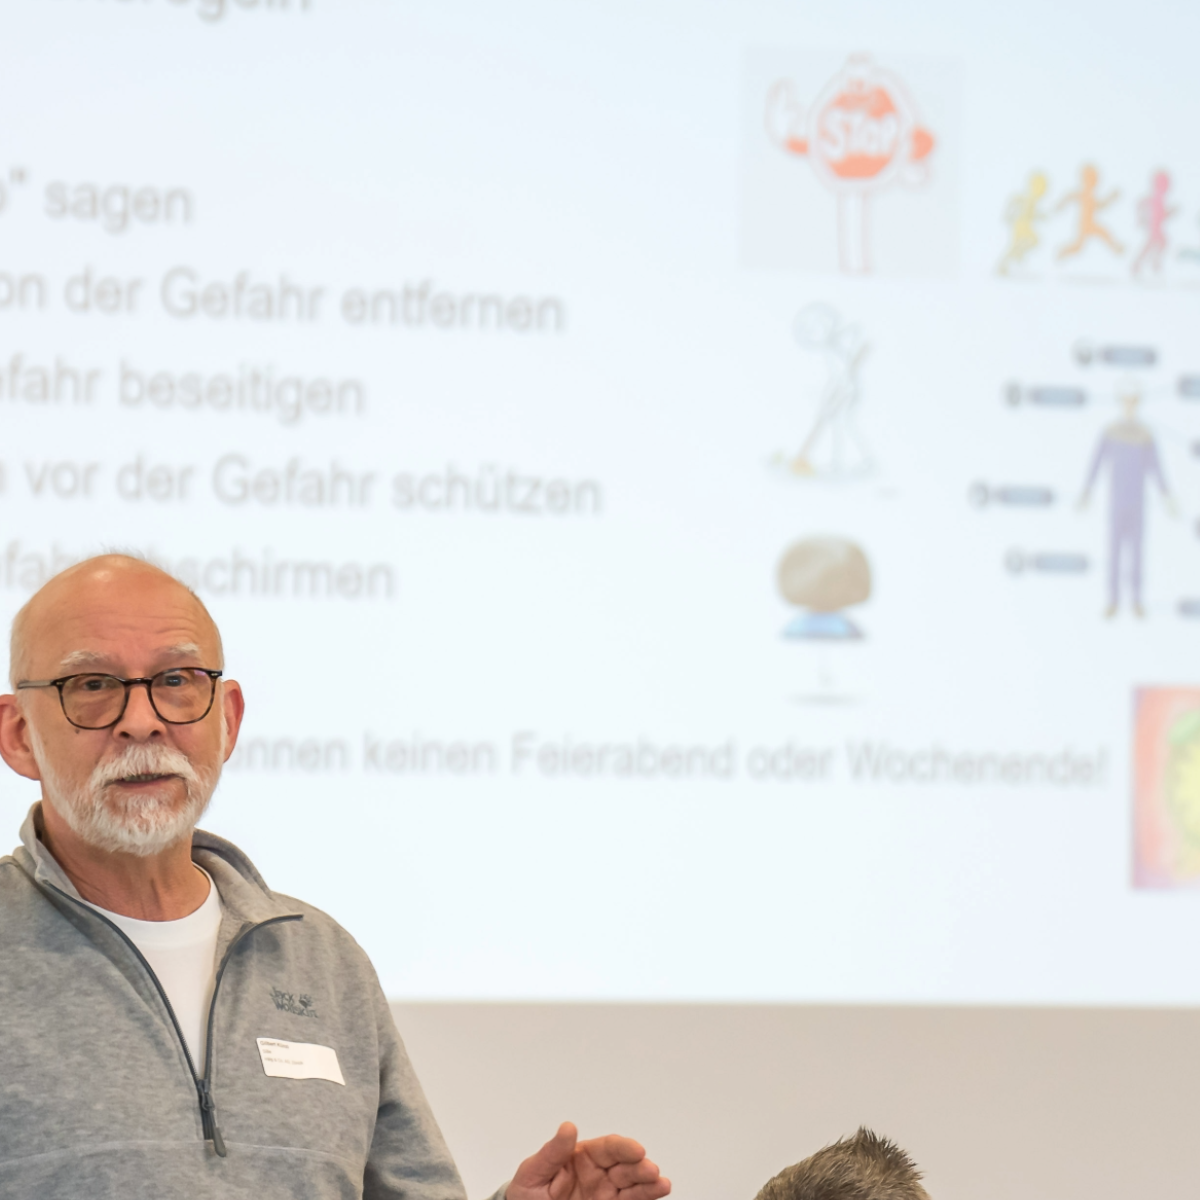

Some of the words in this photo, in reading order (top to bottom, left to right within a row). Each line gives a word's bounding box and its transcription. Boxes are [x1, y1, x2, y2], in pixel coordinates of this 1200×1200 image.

[44, 181, 194, 236] sagen
[64, 265, 143, 315] der
[160, 265, 326, 322] Gefahr
[340, 279, 565, 333] entfernen
[118, 360, 367, 428] beseitigen
[23, 461, 101, 500] vor
[115, 452, 195, 503] der
[211, 452, 377, 508] Gefahr
[392, 463, 603, 516] schützen
[363, 731, 498, 775] keinen
[511, 730, 737, 781] Feierabend
[746, 741, 834, 782] oder
[845, 739, 1109, 788] Wochenende!
